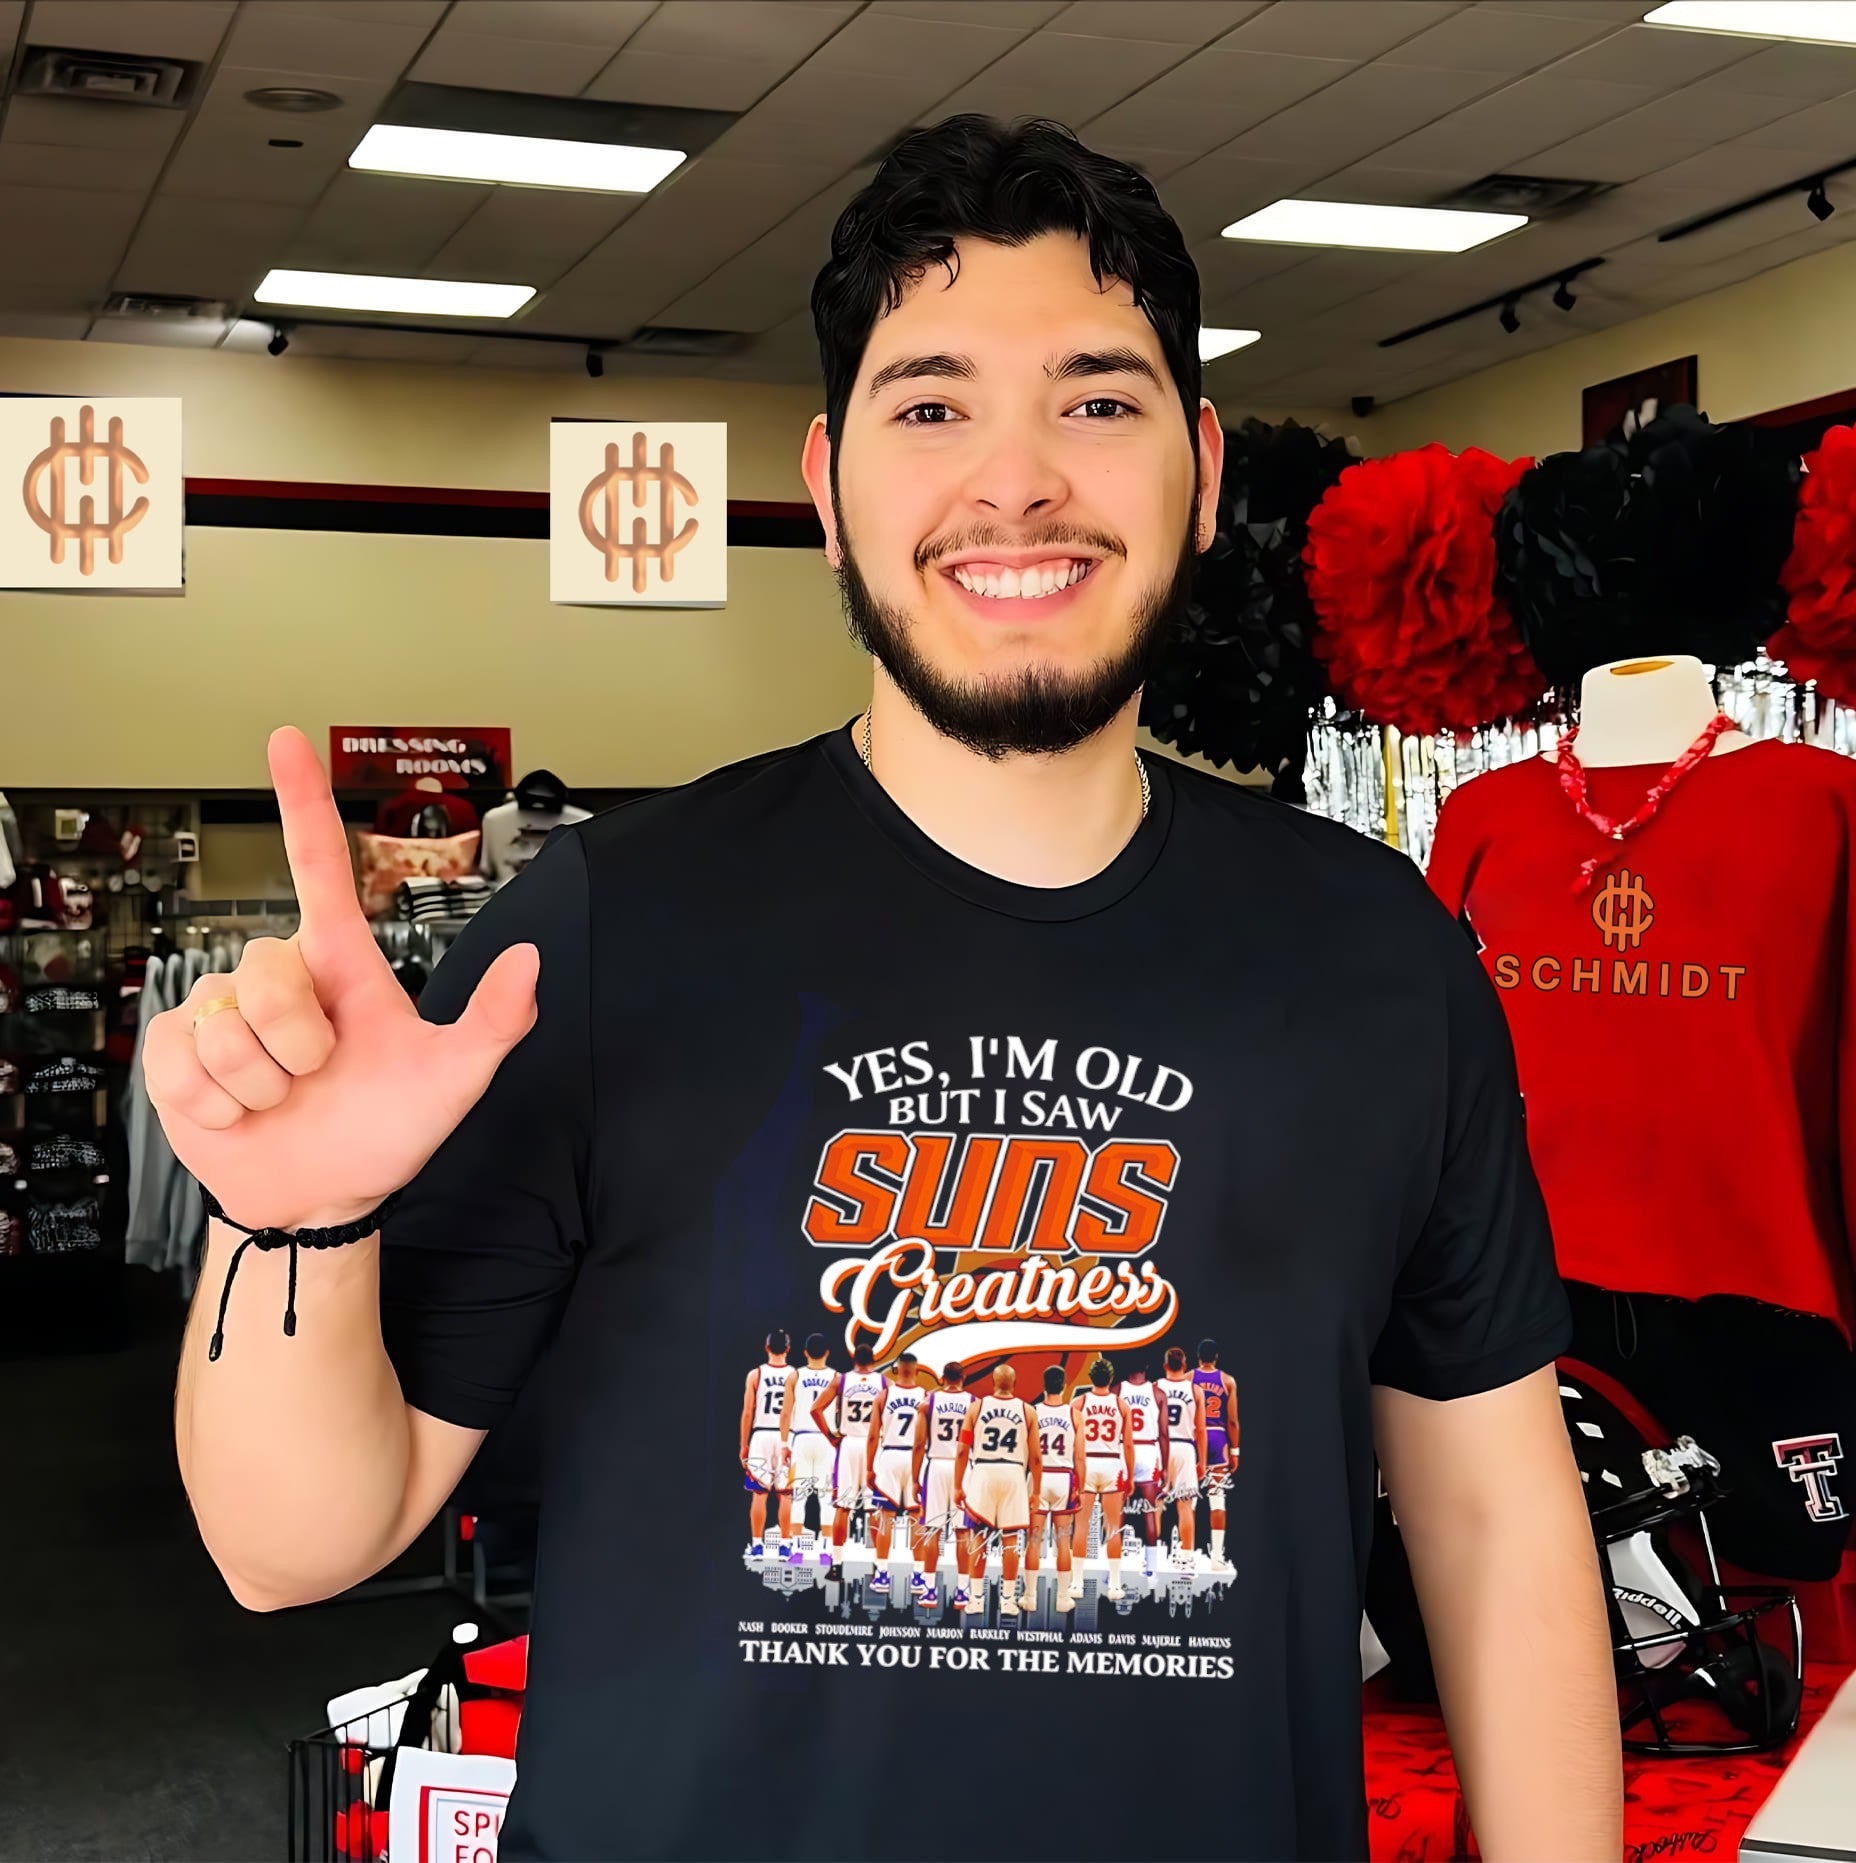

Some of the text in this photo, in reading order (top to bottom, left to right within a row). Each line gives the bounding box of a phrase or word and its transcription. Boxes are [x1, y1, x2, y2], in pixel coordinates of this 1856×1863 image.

[342, 737, 467, 754] DRESSING
[395, 758, 487, 775] ROOMS
[1494, 953, 1747, 1000] SCHMIDT
[822, 1035, 1195, 1113] YES, I'M OLD
[888, 1088, 1124, 1132] BUT I SAW
[801, 1128, 1182, 1258] SUNS
[820, 1237, 1180, 1362] Greatness
[763, 1390, 784, 1415] 13
[847, 1400, 873, 1423] 32
[1205, 1396, 1223, 1419] 2
[897, 1412, 915, 1437] 7
[937, 1418, 964, 1442] 31
[1084, 1419, 1117, 1443] 33
[981, 1426, 1018, 1453] 34
[738, 1621, 765, 1633] NASH
[771, 1622, 808, 1635] BOOKER
[815, 1623, 874, 1637] STOUDEMIRE
[879, 1625, 921, 1639] JOHNSON
[926, 1627, 964, 1640] MARION
[970, 1628, 1011, 1641] BARKLEY
[1016, 1630, 1065, 1644] WESTPHAL
[1069, 1631, 1104, 1645] ADAMS
[1108, 1633, 1137, 1646] DAVIS
[1188, 1636, 1232, 1650] HAWKINS
[739, 1639, 1236, 1680] THANK YOU FOR THE MEMORIES
[453, 1809, 500, 1838] SPI
[455, 1844, 494, 1863] FO
